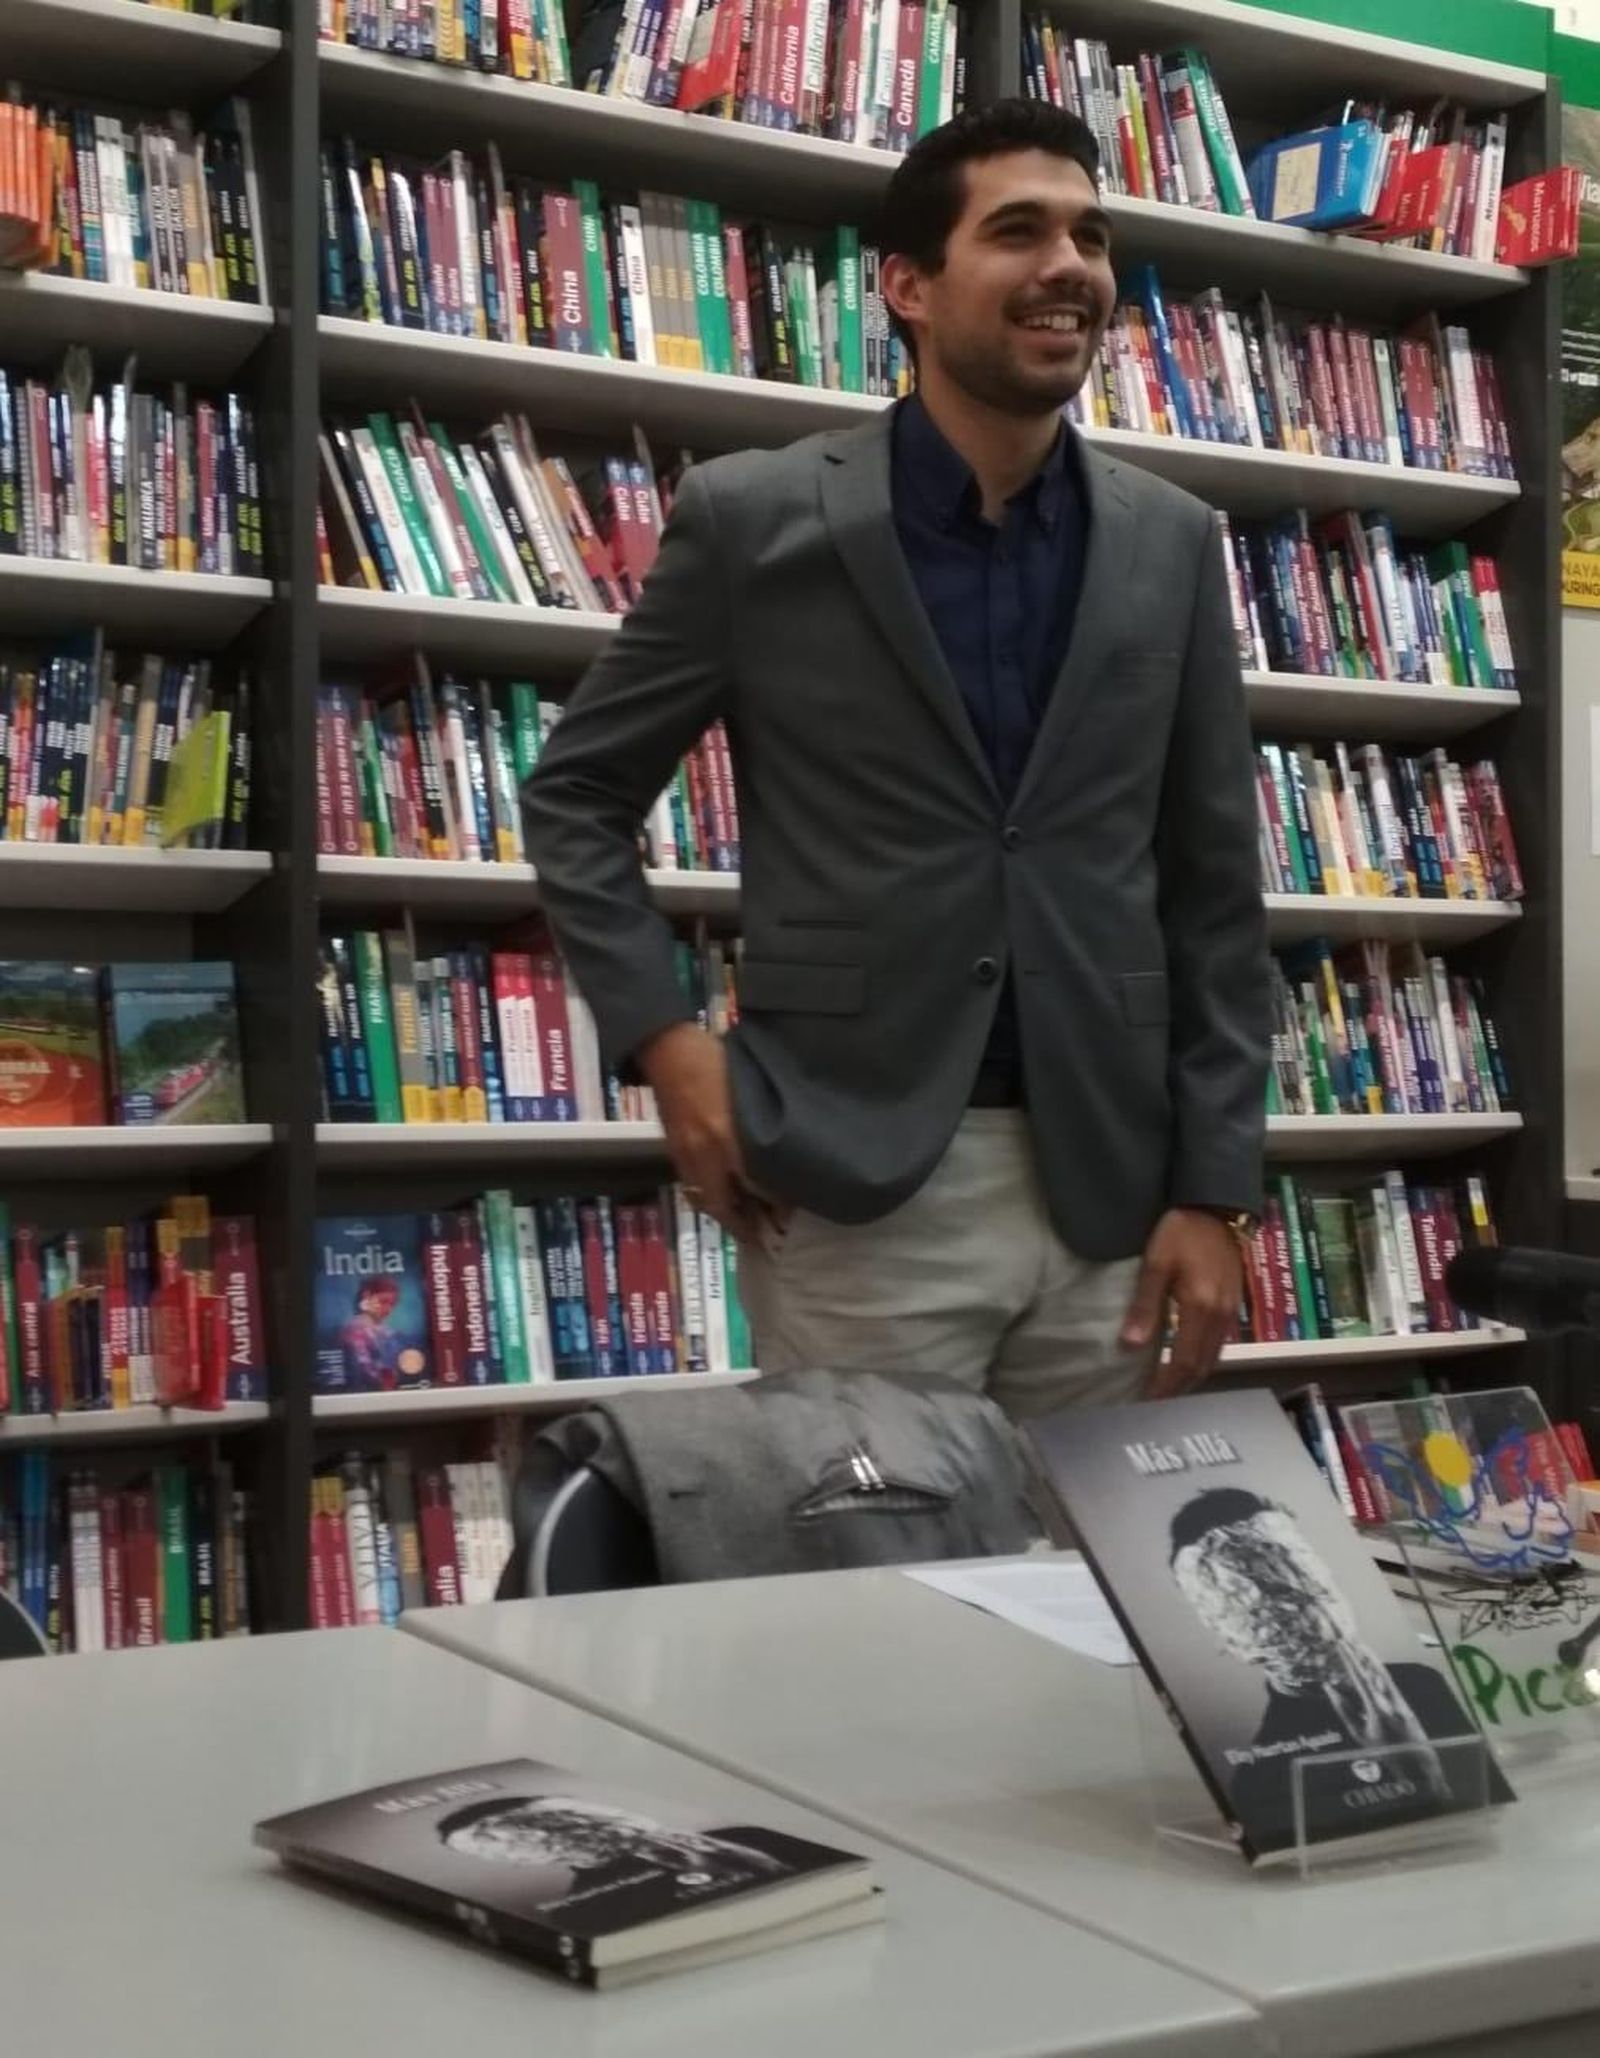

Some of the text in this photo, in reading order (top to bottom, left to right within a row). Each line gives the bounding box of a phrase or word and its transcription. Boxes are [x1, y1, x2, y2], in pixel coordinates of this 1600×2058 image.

[781, 25, 799, 104] California
[805, 2, 825, 88] California
[843, 60, 857, 111] Camboya
[897, 59, 915, 125] Canadá
[582, 214, 597, 251] CHINA
[1530, 181, 1545, 253] Marruecos
[629, 255, 645, 296] China
[692, 233, 709, 296] COLOMBIA
[709, 236, 725, 297] COLOMBIA
[769, 265, 783, 312] COLOMBIA
[562, 271, 581, 324] China
[736, 300, 750, 350] Colombia
[1412, 416, 1424, 445] Nepal
[233, 445, 247, 494] MALLORCA
[386, 446, 414, 503] CROACIA
[444, 456, 467, 491] CUBA
[140, 481, 154, 540] MALLORCA
[202, 497, 214, 538] Mallorca
[508, 507, 524, 534] CUBA
[615, 486, 631, 522] Cuba
[635, 489, 652, 525] Cuba
[1308, 571, 1329, 650] Nueva Zelanda
[399, 991, 417, 1054] Francia
[546, 1029, 568, 1091] Francia
[324, 1245, 406, 1276] India
[706, 1246, 721, 1299] Irlanda
[1421, 1214, 1442, 1281] Tailandia
[431, 1245, 456, 1332] Indonesia
[1281, 1272, 1294, 1289] de
[1285, 1292, 1298, 1315] Sur
[226, 1271, 252, 1366] Australia
[462, 1264, 486, 1353] Indonesia
[596, 1319, 611, 1344] Irán
[630, 1292, 647, 1344] Irlanda
[655, 1291, 672, 1342] Irlanda
[21, 1301, 39, 1378] Asia central
[1126, 1431, 1239, 1474] Más Allá
[168, 1504, 183, 1555] BRASIL
[376, 1523, 392, 1568] ITALIA
[198, 1542, 212, 1586] BRASIL
[136, 1597, 154, 1646] Brasil
